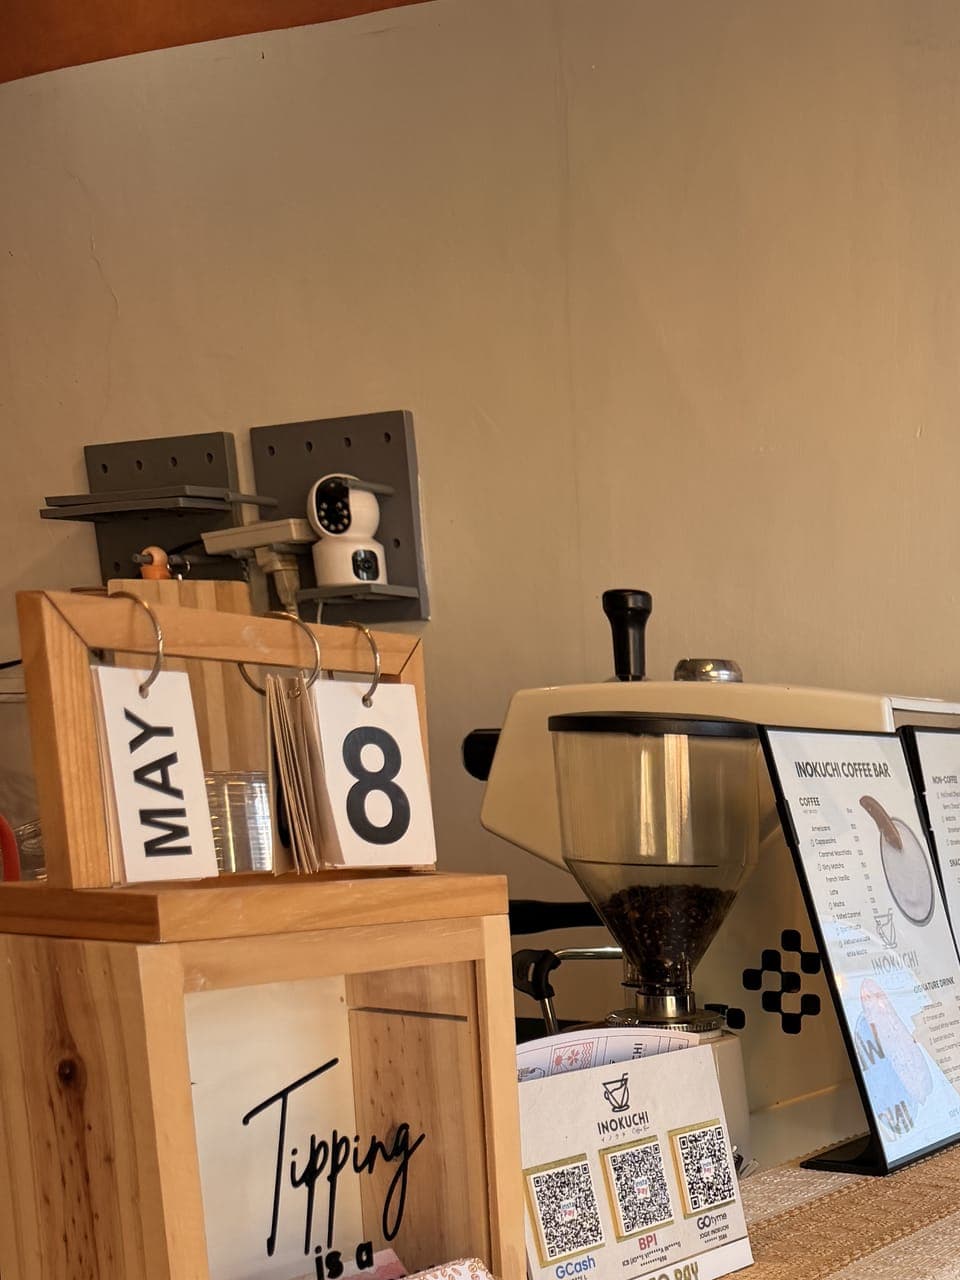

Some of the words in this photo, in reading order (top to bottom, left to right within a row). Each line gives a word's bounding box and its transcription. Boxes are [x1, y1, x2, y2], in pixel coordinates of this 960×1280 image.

[795, 761, 842, 778] INOKUCHI
[841, 762, 873, 778] COFFEE
[873, 762, 891, 778] BAR
[124, 706, 192, 858] MAY
[342, 726, 411, 845] 8
[799, 797, 821, 807] COFFEE
[939, 976, 955, 988] DRINK
[597, 1110, 650, 1135] INOKUCHI
[242, 1057, 426, 1256] Tipping
[638, 1233, 658, 1251] BPI
[355, 1240, 374, 1271] a
[555, 1255, 596, 1279] GCash
